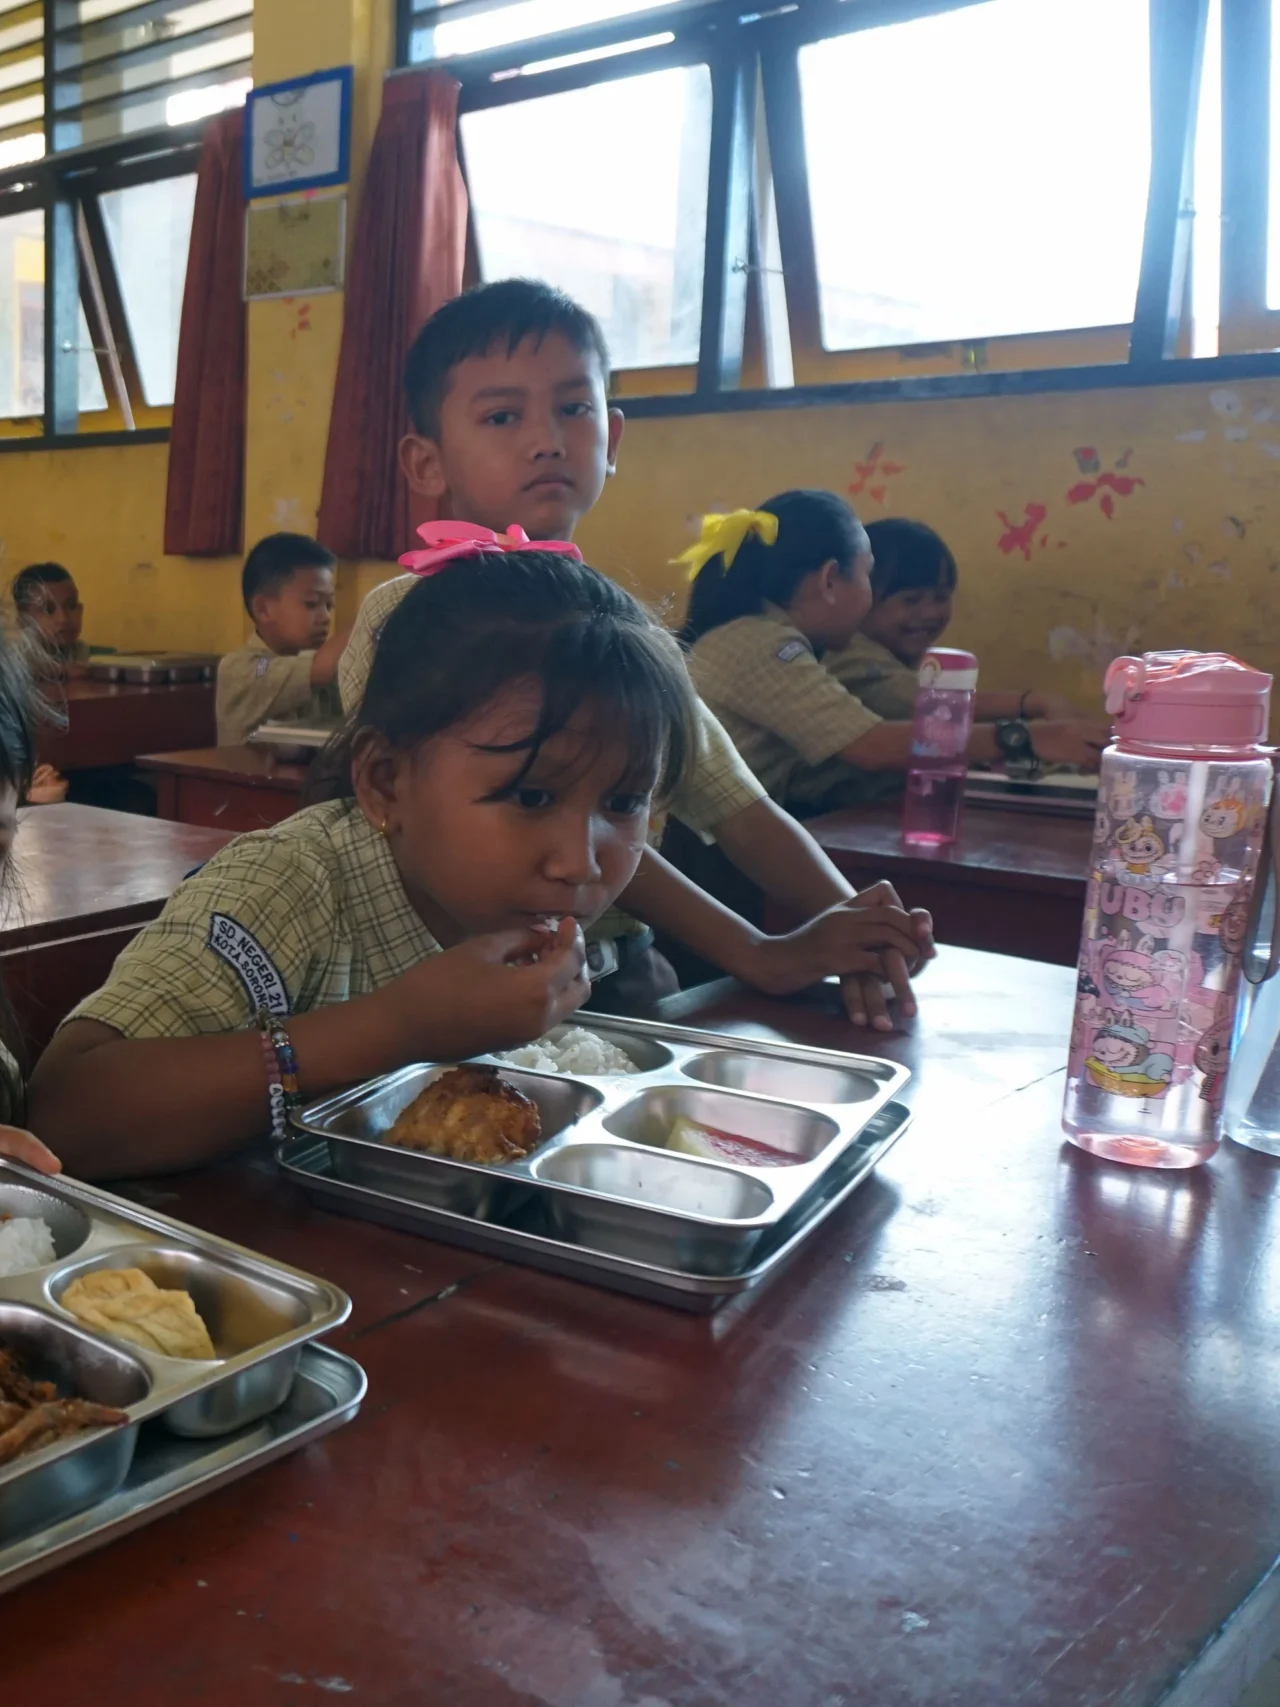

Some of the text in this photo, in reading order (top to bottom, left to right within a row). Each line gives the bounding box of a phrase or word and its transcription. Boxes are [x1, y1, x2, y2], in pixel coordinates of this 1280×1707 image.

[214, 934, 241, 962] KOTA
[219, 920, 283, 1009] SD NEGERI 21
